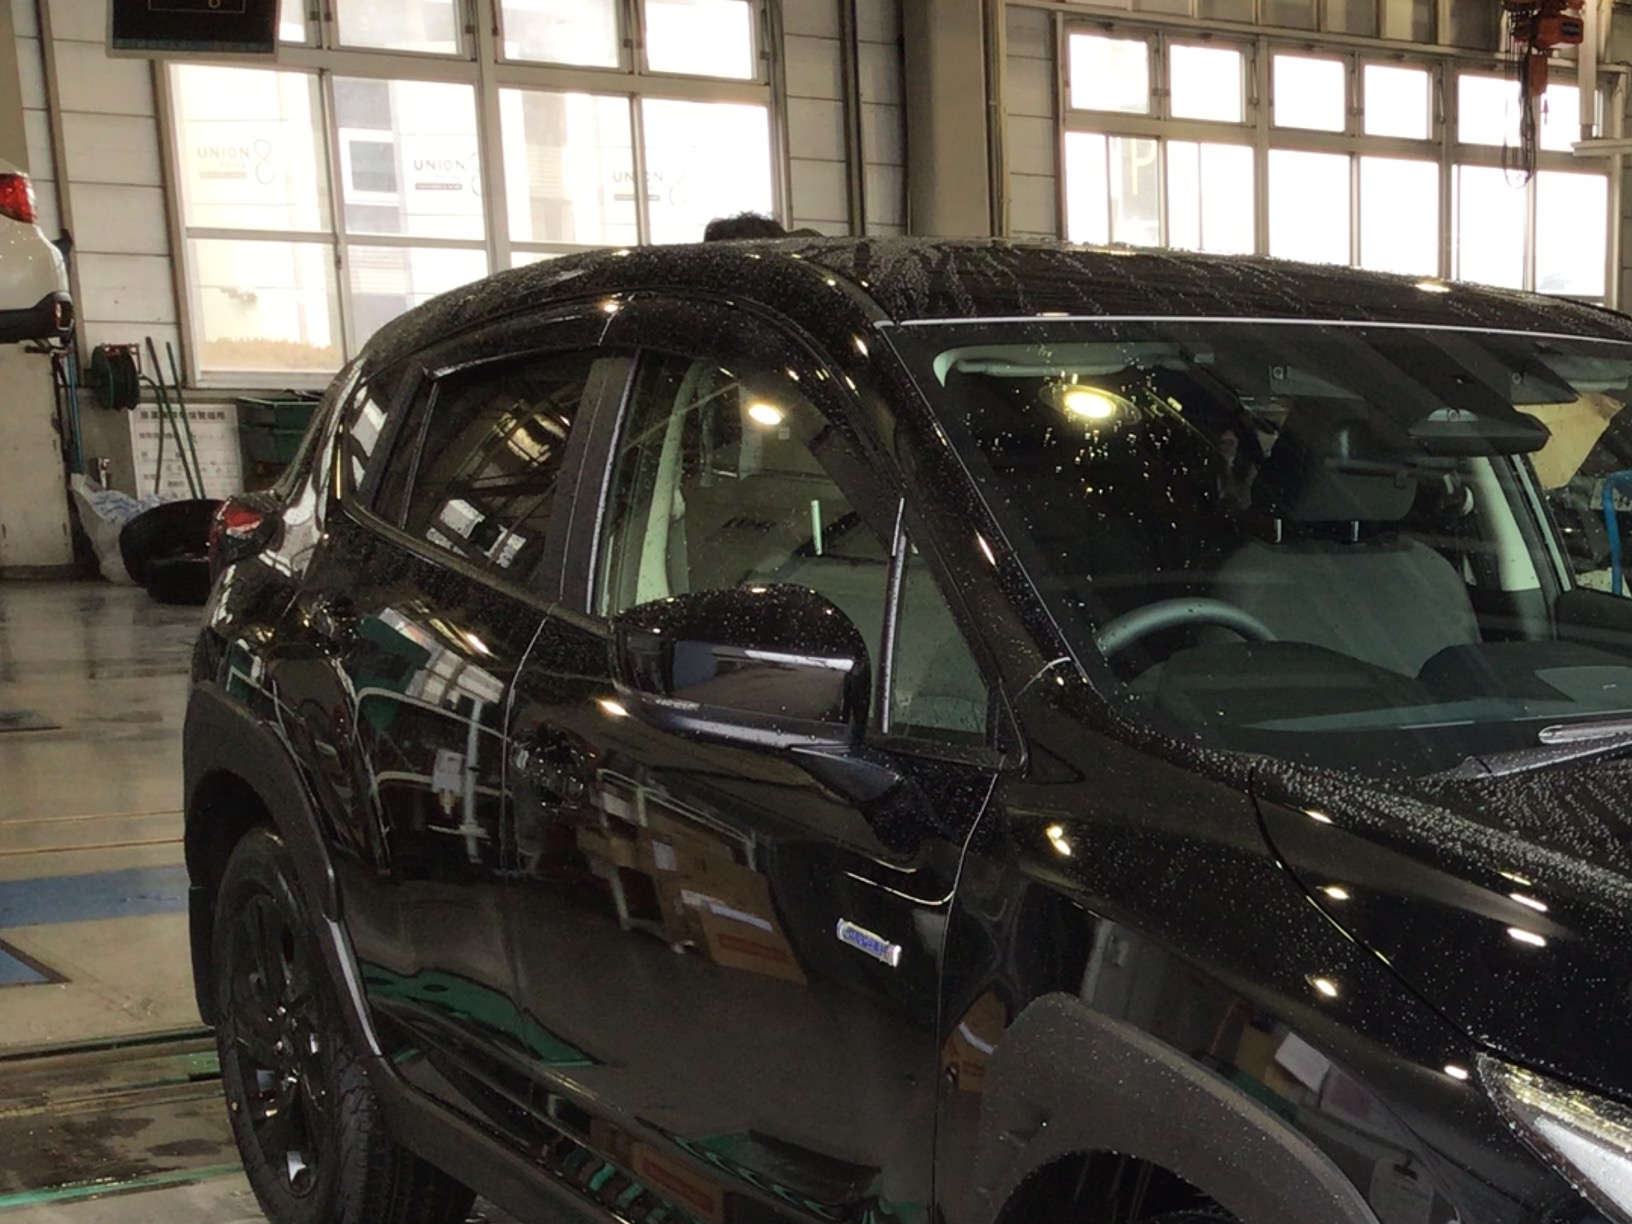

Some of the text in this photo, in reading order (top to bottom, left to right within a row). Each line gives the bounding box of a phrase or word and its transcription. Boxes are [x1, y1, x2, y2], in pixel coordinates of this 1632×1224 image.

[197, 147, 249, 159] UNION
[413, 159, 466, 171] UNION
[613, 171, 663, 182] UNN
